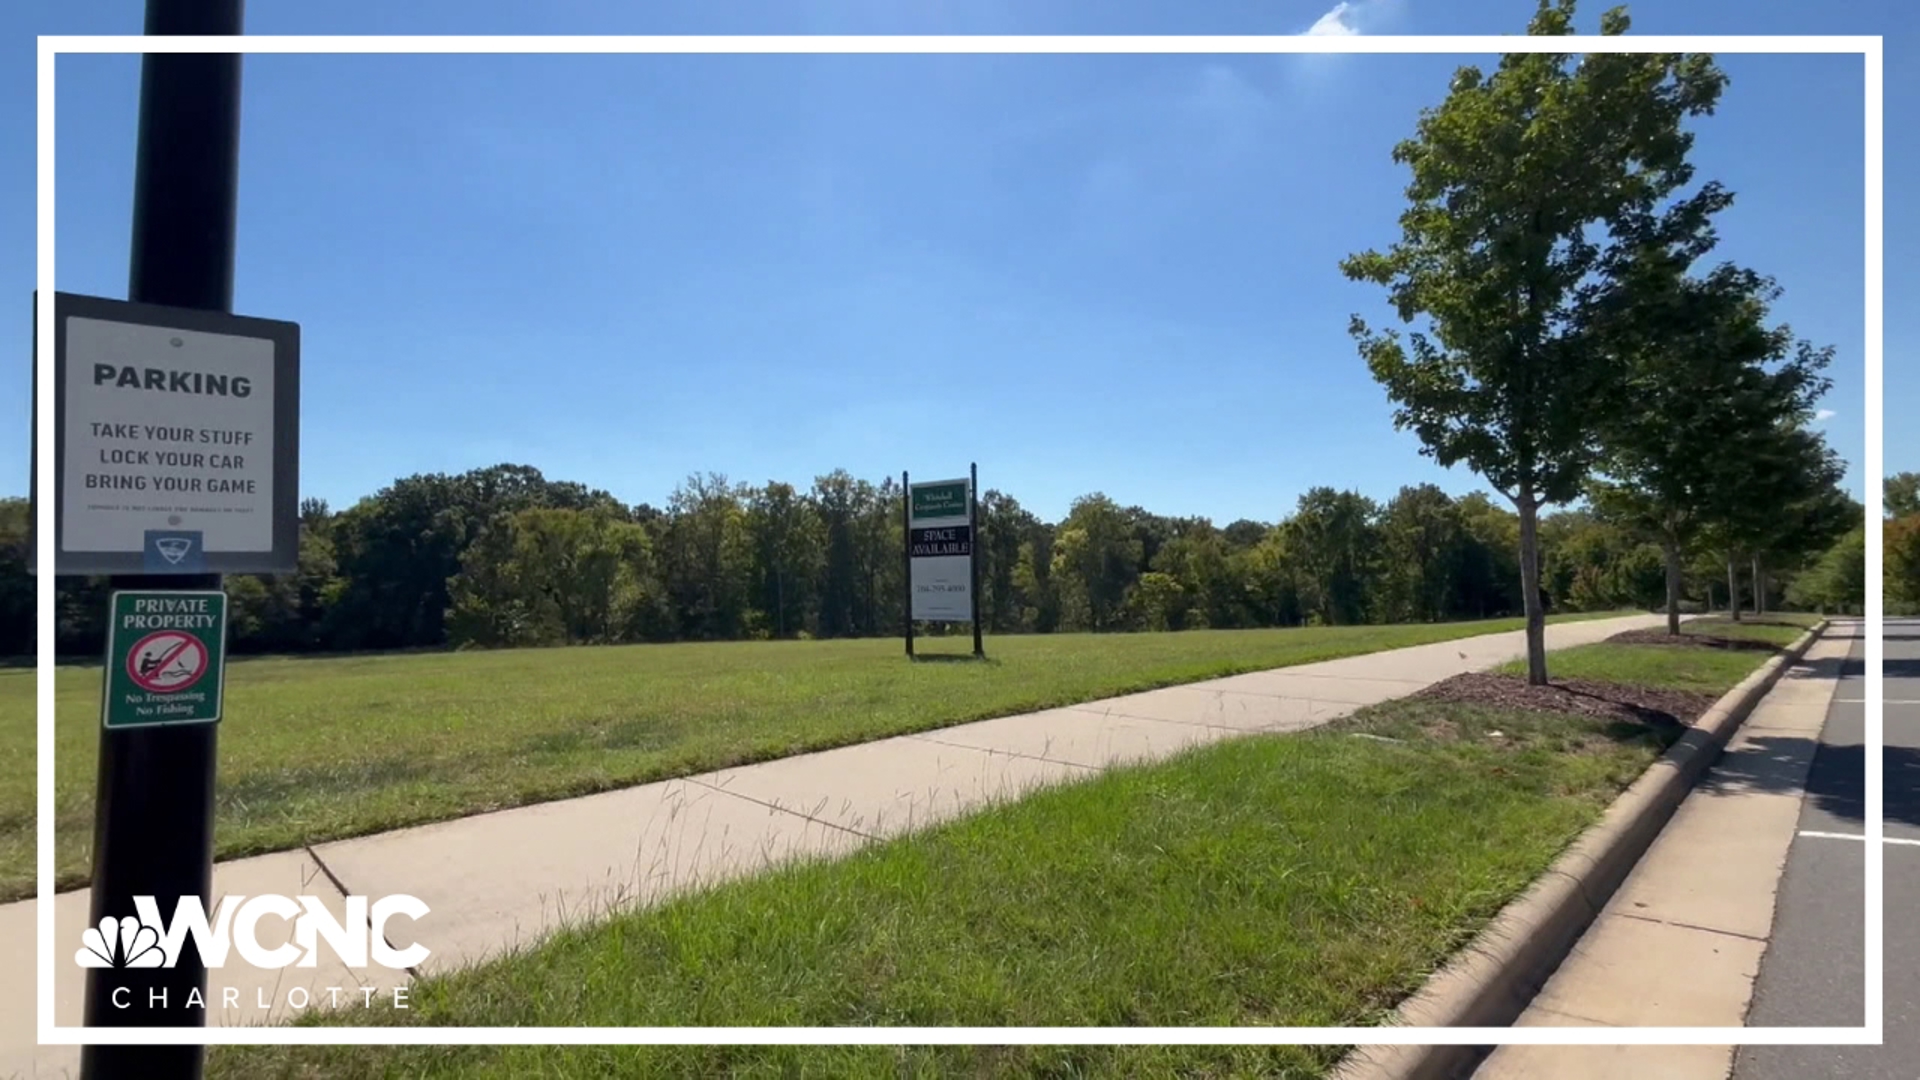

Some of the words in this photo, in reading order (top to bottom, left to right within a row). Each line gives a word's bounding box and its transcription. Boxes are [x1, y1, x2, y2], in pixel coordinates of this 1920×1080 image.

[94, 363, 251, 398] PARKING
[91, 422, 139, 440] TAKE
[144, 425, 194, 443] YOUR
[199, 429, 253, 446] STUFF
[100, 449, 149, 465] LOCK
[155, 451, 204, 469] YOUR
[209, 454, 244, 470] CAR
[85, 474, 147, 490] BRING
[152, 477, 202, 492] YOUR
[206, 479, 256, 494] GAME
[923, 529, 956, 541] SPACE
[913, 542, 968, 555] AVAILABLE
[135, 599, 208, 613] PRIVATE
[123, 614, 216, 629] PROPERTY
[126, 694, 142, 704] No
[146, 692, 205, 704] Trespassing
[136, 706, 153, 716] No
[157, 705, 194, 716] Fishing
